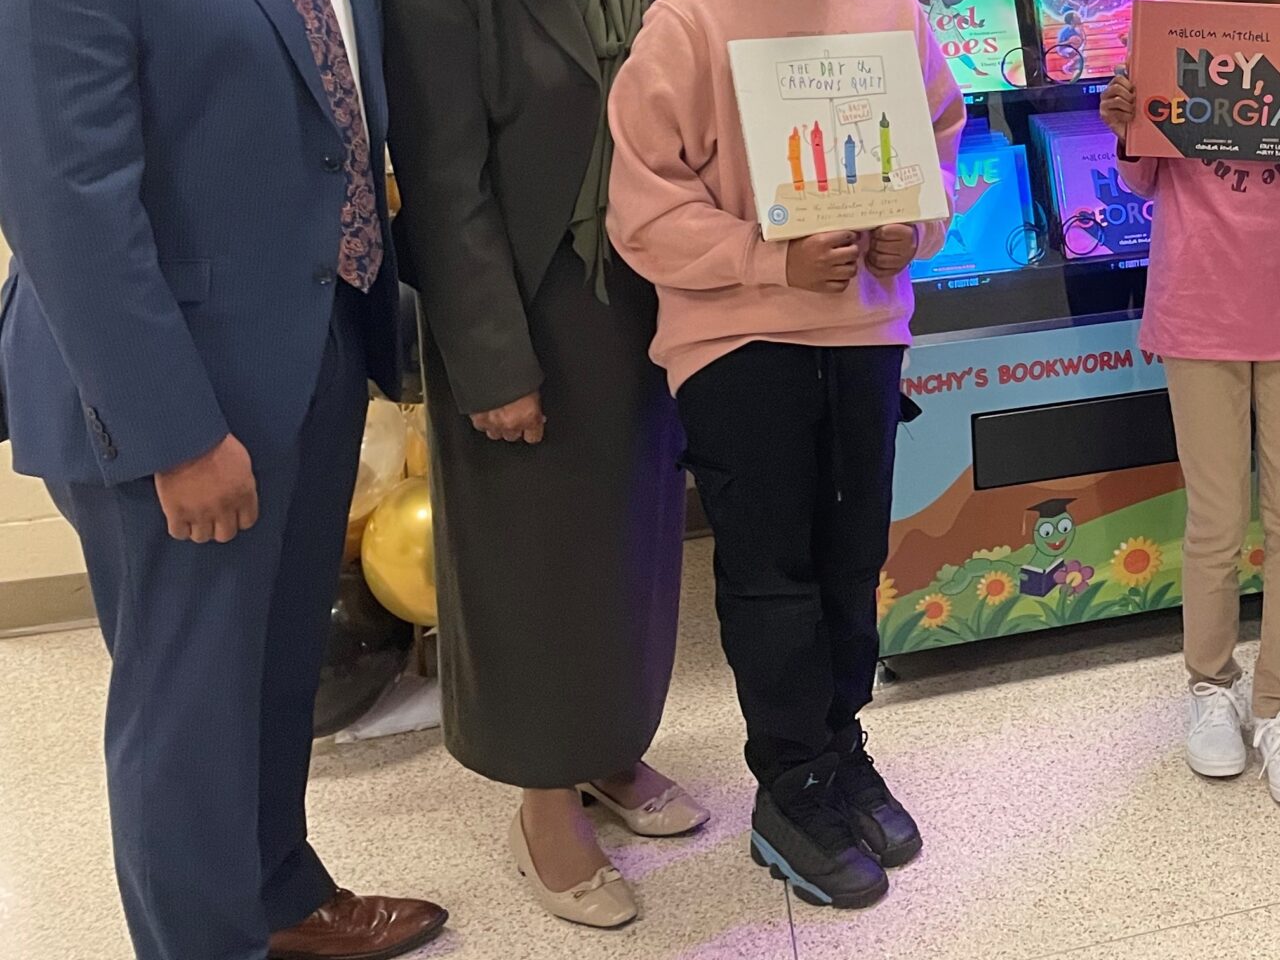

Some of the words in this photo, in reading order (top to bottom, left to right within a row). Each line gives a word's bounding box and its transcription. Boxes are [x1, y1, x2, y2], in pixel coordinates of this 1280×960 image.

[936, 6, 978, 31] ed
[942, 37, 998, 58] oes
[788, 63, 810, 75] THE
[820, 62, 846, 78] DAY
[857, 60, 872, 74] the
[780, 76, 842, 91] CRAYONS
[850, 75, 883, 94] QUIT
[902, 366, 989, 397] NCHY'S
[998, 349, 1133, 385] BOOKWORM
